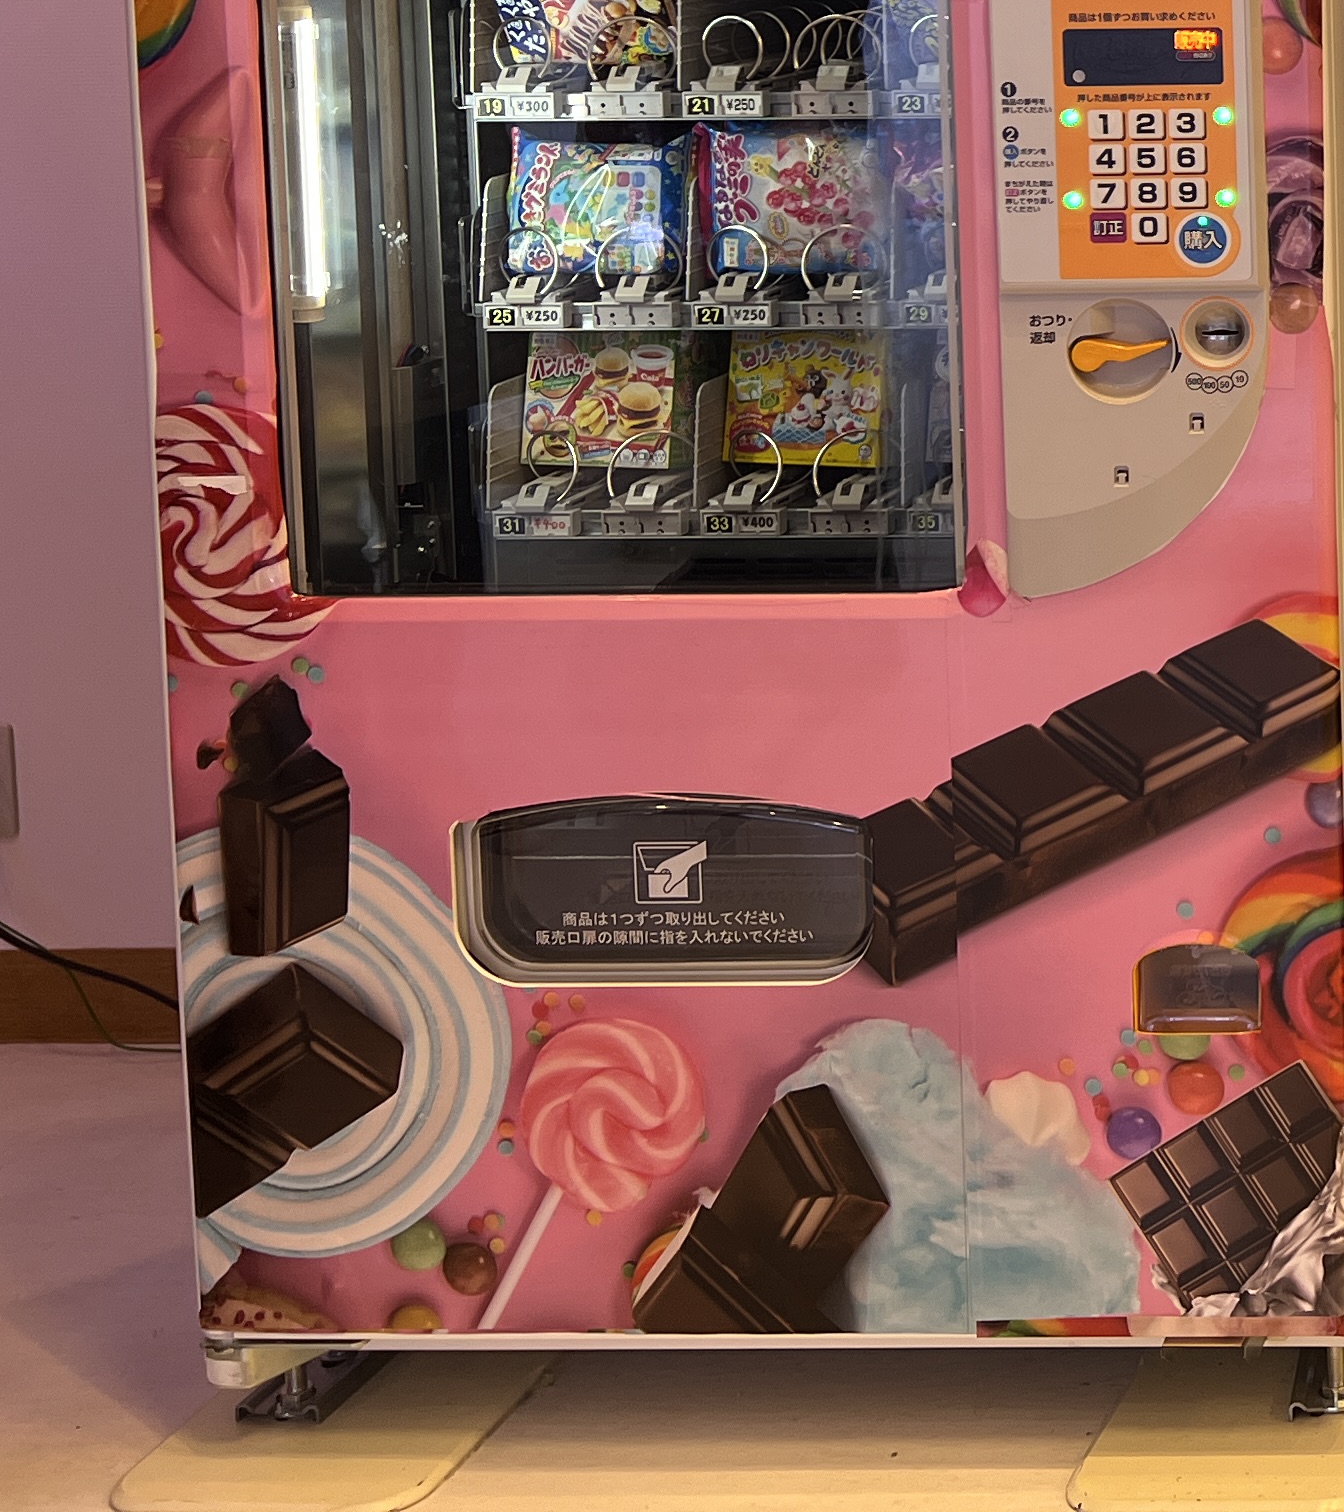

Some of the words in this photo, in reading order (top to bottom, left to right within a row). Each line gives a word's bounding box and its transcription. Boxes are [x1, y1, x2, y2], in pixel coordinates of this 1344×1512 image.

[1068, 12, 1215, 22] 商品は1個ずつお買い求めください
[692, 97, 710, 112] 21
[726, 97, 756, 111] ¥250
[1077, 93, 1211, 101] 押した商品番号が上に表示されます
[483, 98, 502, 113] 19
[517, 99, 549, 113] ¥300
[1098, 114, 1109, 134] 1
[1136, 114, 1155, 134] 2
[1176, 113, 1196, 133] 3
[1096, 148, 1116, 168] 4
[1137, 148, 1156, 168] 5
[1177, 147, 1196, 168] 6
[1097, 183, 1116, 203] 7
[1138, 183, 1157, 203] 8
[1178, 182, 1197, 202] 9
[1093, 220, 1124, 236] 訂正
[1139, 216, 1158, 237] 0
[1184, 231, 1222, 250] 購入
[493, 309, 513, 324] 25
[525, 309, 558, 322] ¥250
[701, 308, 720, 323] 27
[733, 308, 766, 322] ¥250
[1030, 332, 1056, 345] 返却
[530, 353, 591, 380] ハンバーガー
[710, 516, 730, 531] 33
[742, 515, 774, 529] ¥400
[562, 911, 785, 927] 商品は1つずつ取り出してください
[535, 929, 814, 946] 販売口扉の隙間に指を入れないでください
